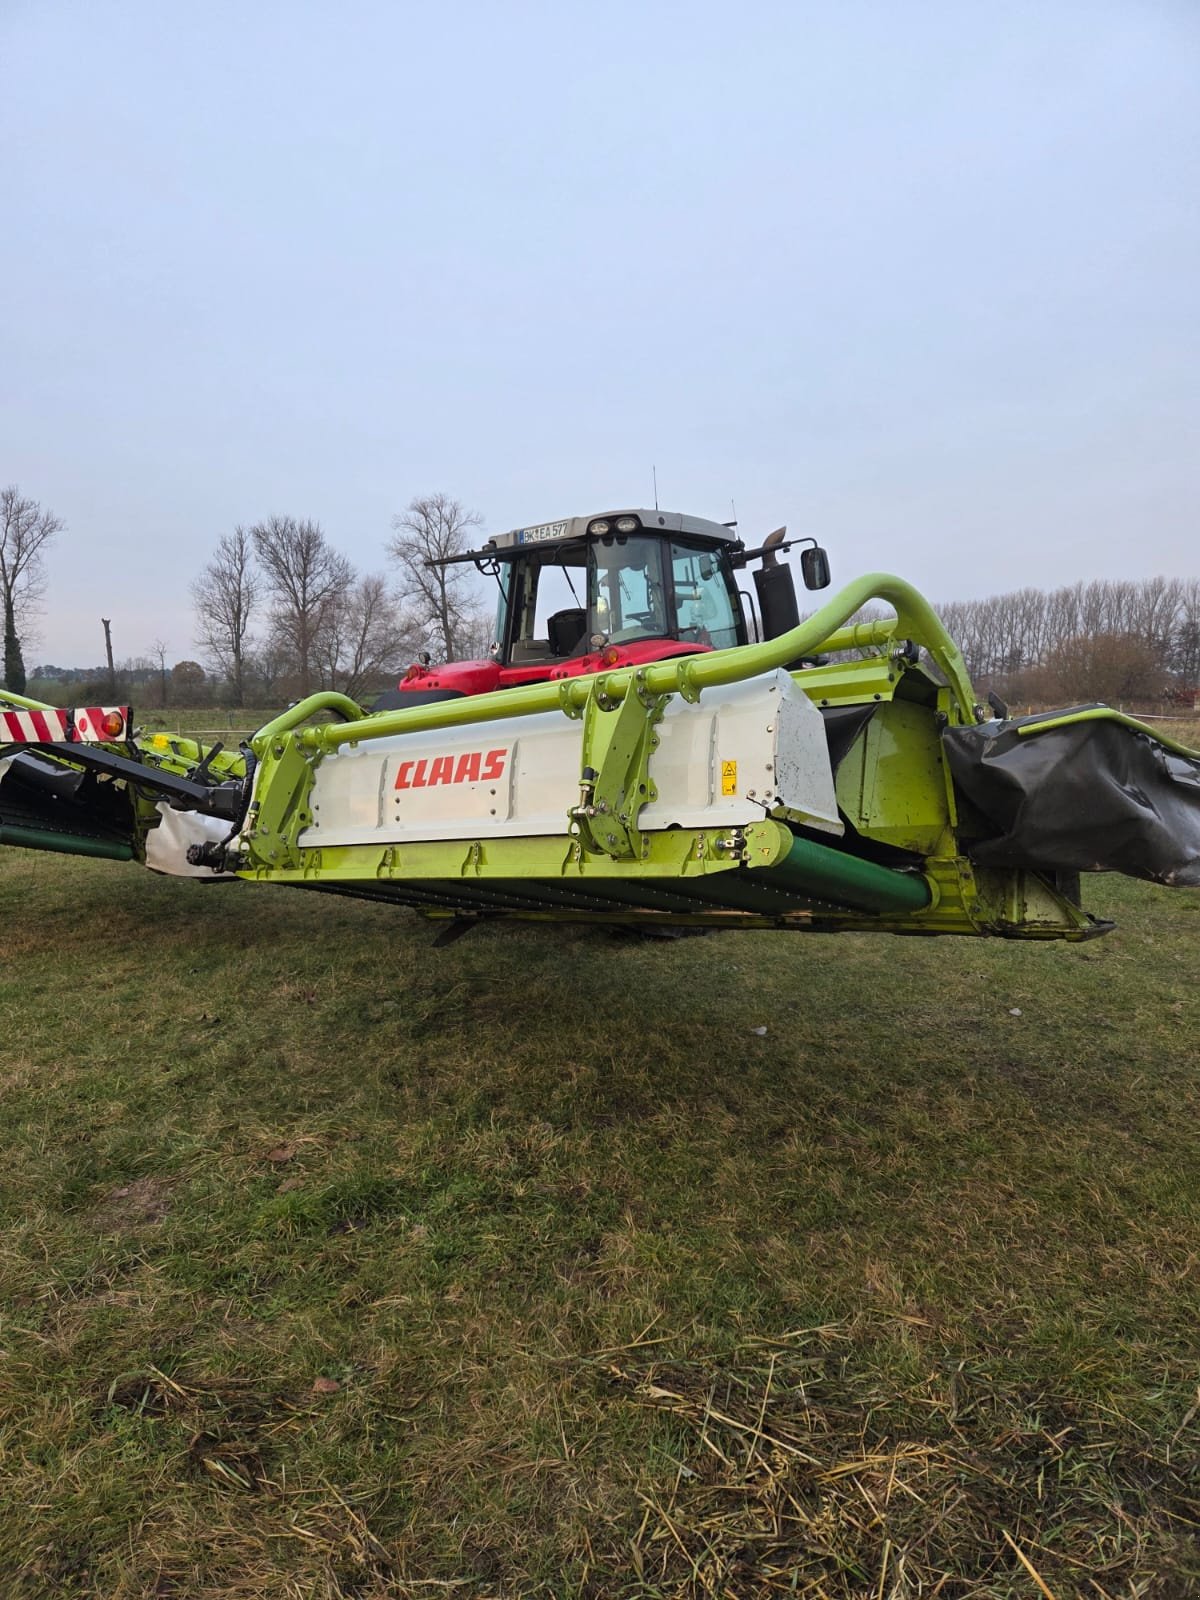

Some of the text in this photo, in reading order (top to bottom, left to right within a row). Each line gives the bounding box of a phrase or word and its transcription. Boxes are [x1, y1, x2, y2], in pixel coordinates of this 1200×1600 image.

[540, 527, 551, 540] EA
[552, 523, 568, 536] 577
[394, 749, 507, 789] CLAAS
